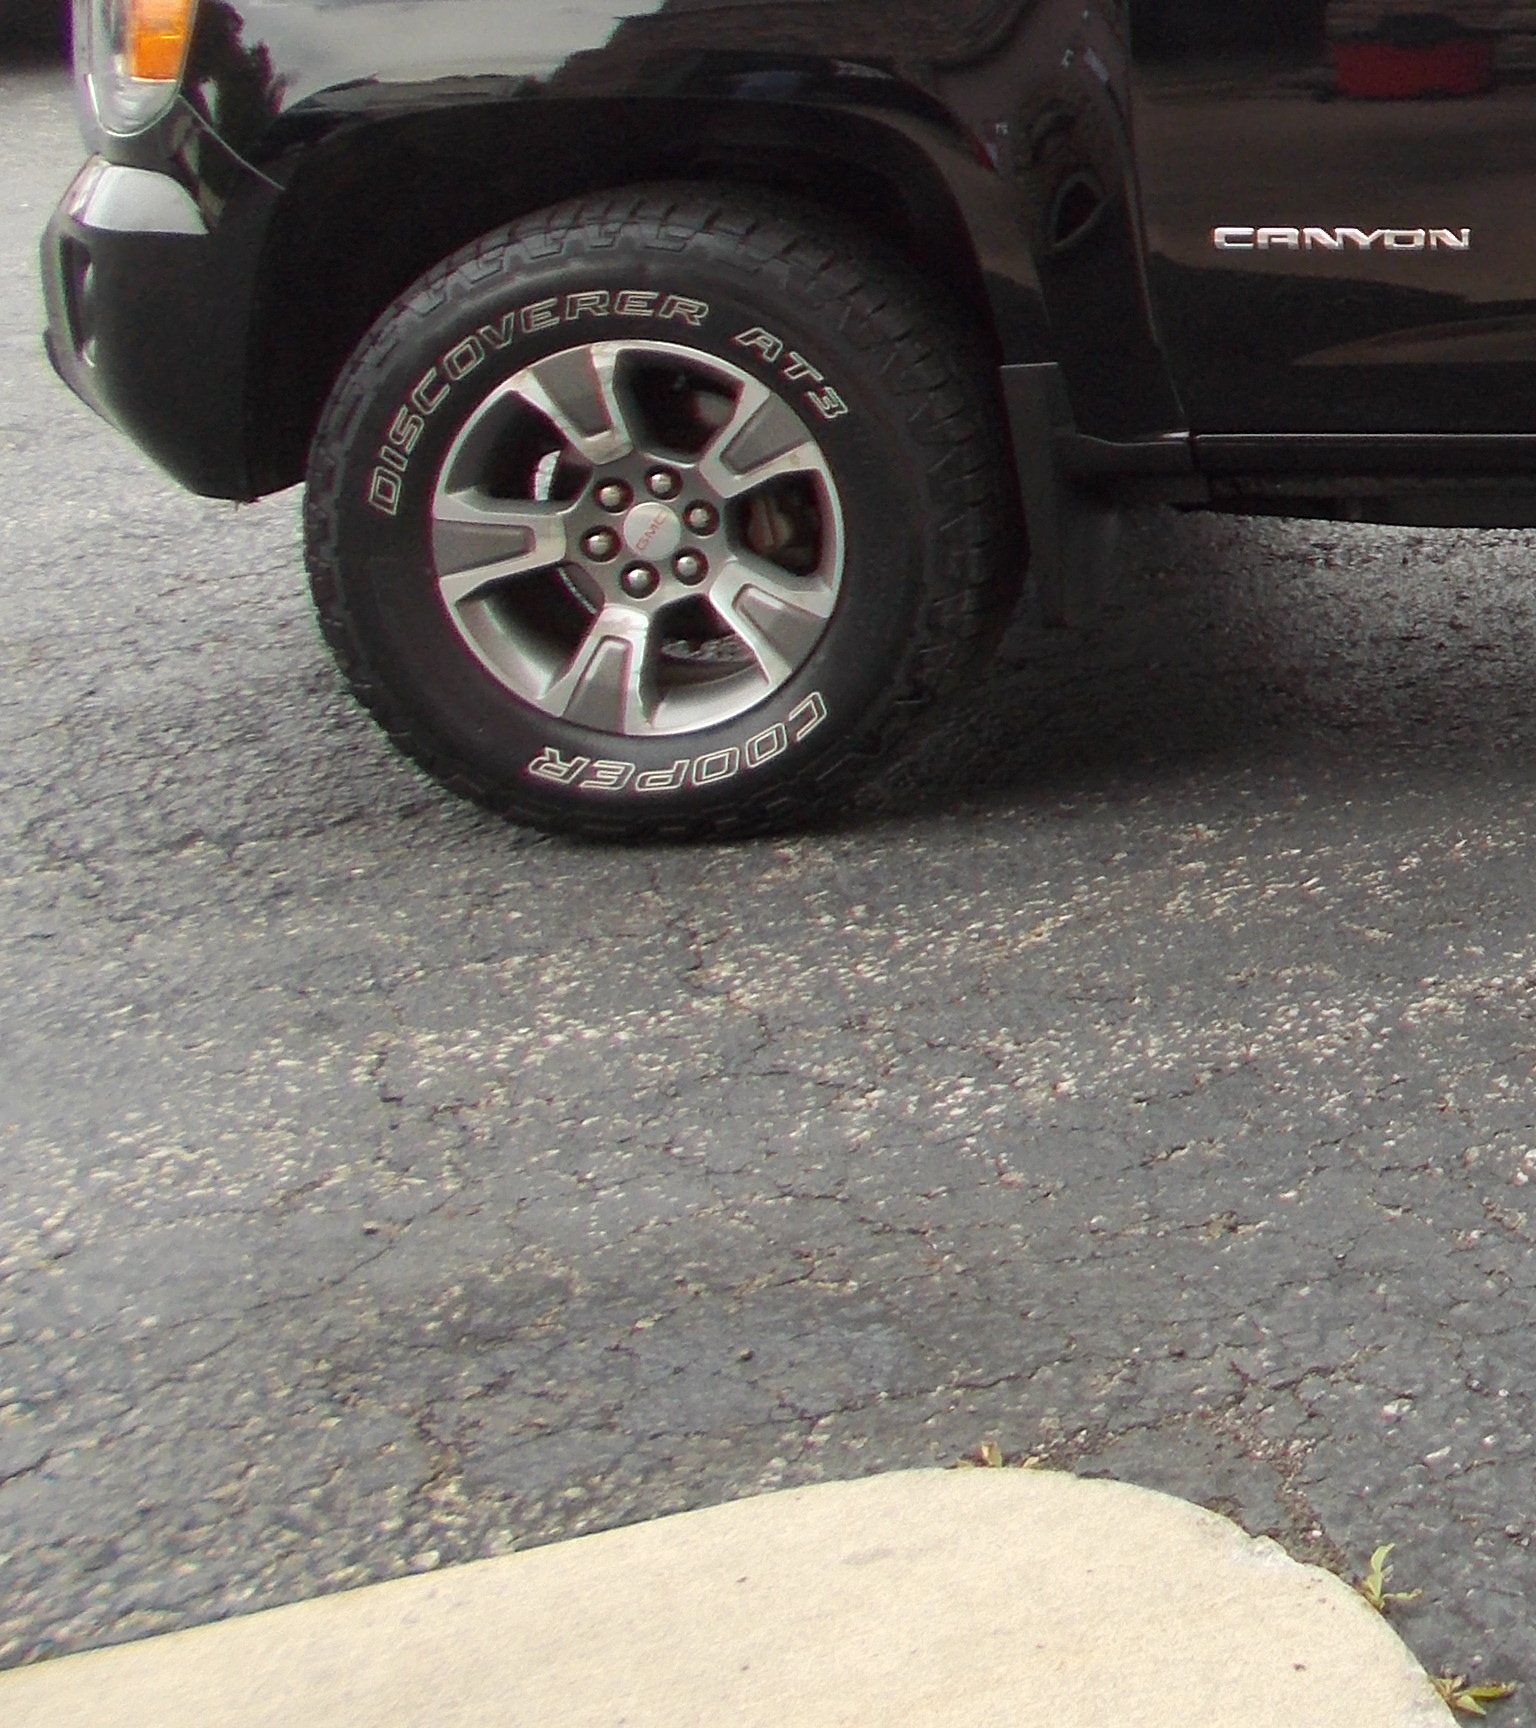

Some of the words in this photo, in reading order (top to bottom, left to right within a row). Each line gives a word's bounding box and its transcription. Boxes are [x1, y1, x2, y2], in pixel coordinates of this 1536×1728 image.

[1213, 226, 1471, 251] CANYON
[367, 289, 709, 516] DISCOVERER
[734, 325, 849, 422] AT3
[527, 690, 830, 793] COOPER
